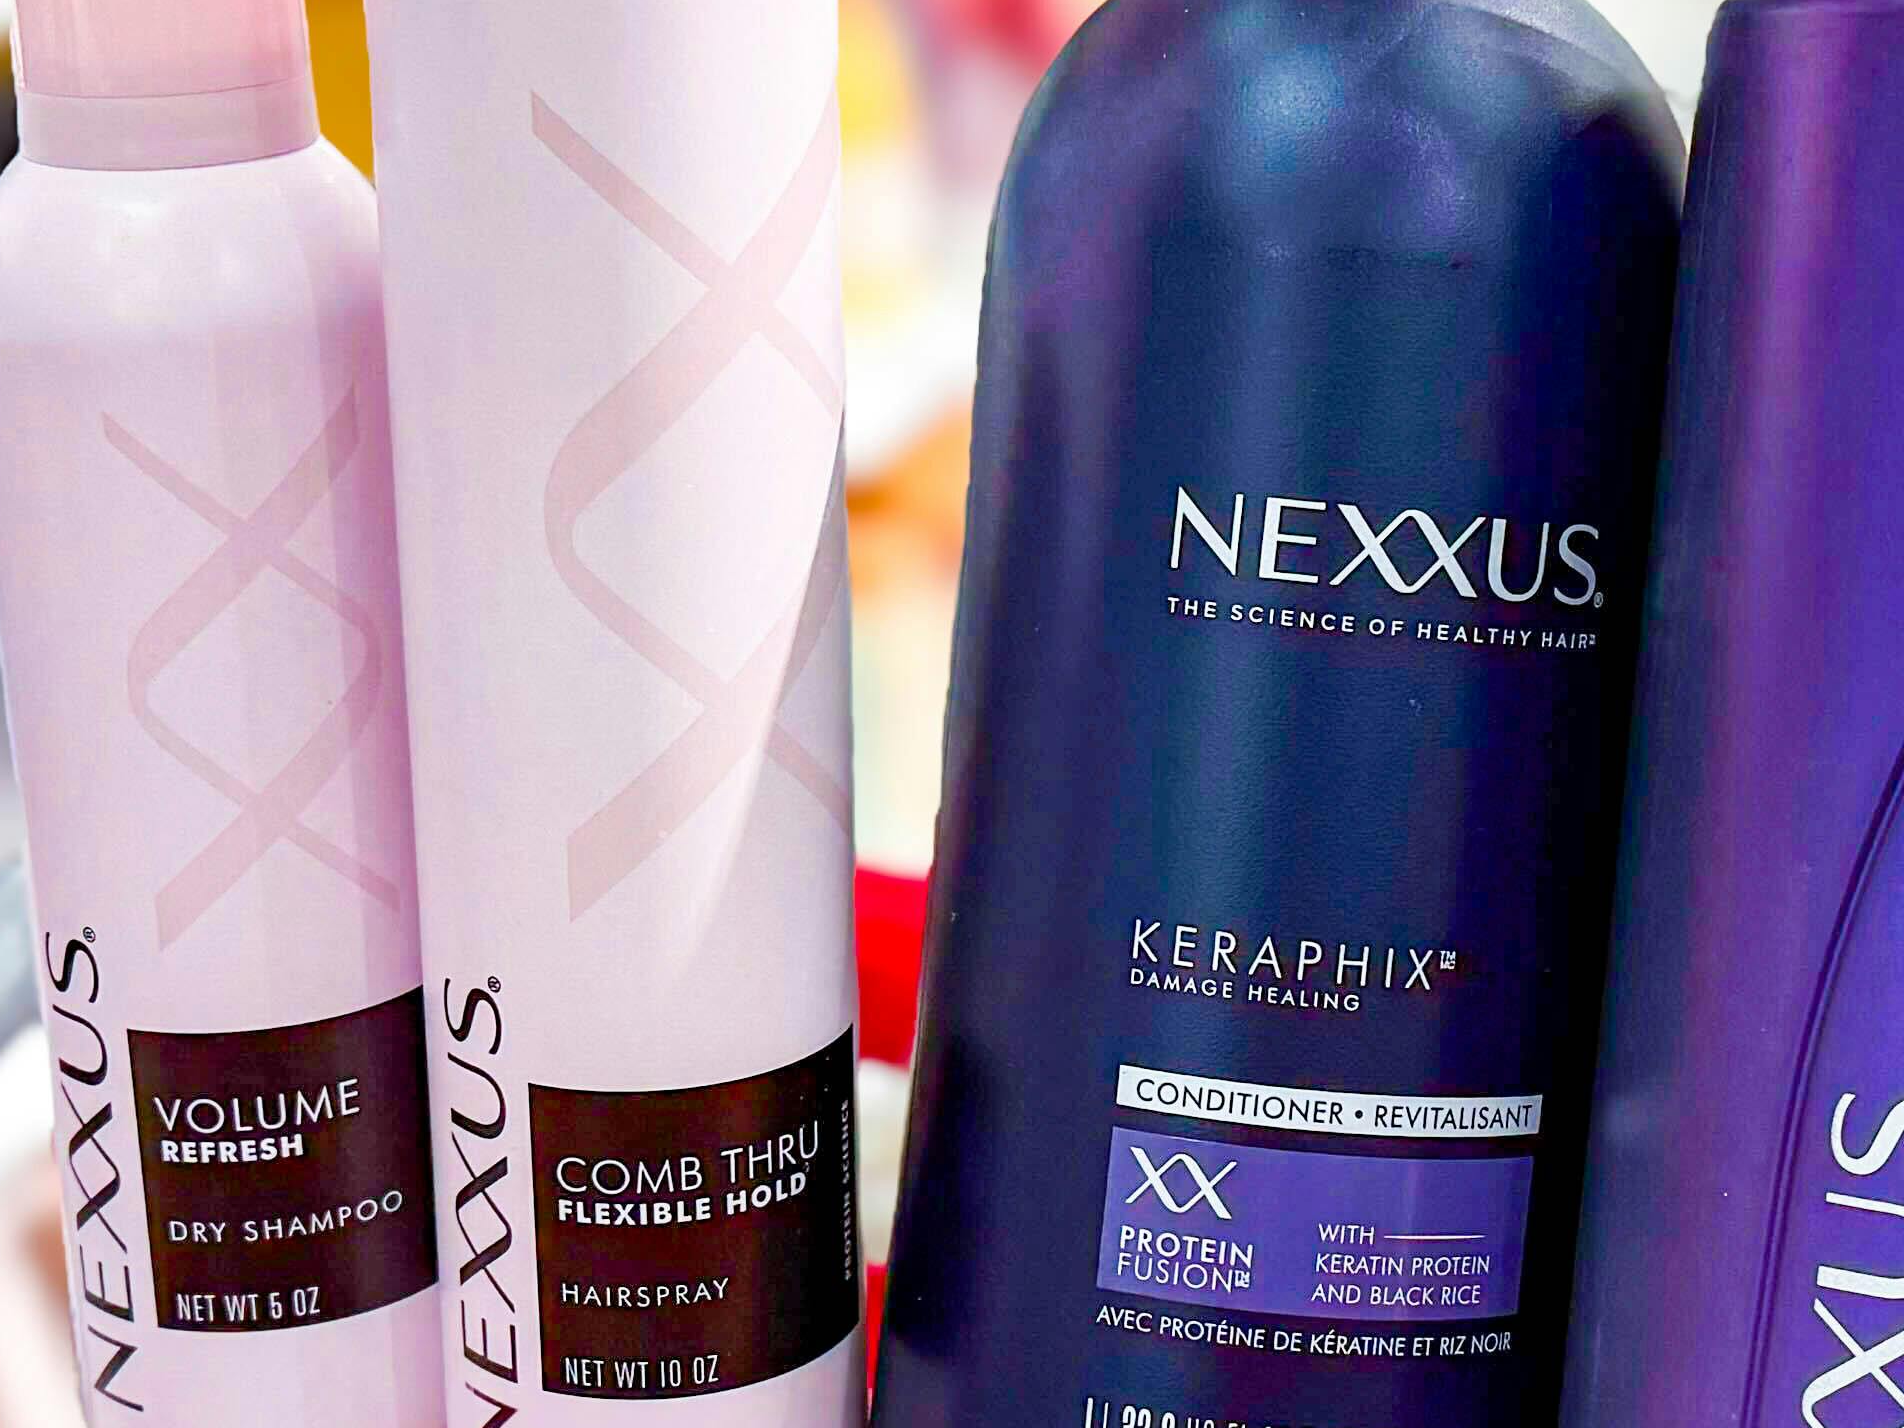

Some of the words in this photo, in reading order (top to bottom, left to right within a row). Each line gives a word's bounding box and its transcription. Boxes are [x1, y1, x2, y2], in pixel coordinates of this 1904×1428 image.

[1168, 597, 1217, 619] THE
[1231, 605, 1355, 633] SCIENCE
[1370, 619, 1404, 636] OF
[1417, 623, 1531, 648] HEALTHY
[1130, 968, 1233, 999] DAMAGE
[1248, 984, 1360, 1012] HEALING
[153, 1078, 360, 1134] VOLUME
[1135, 1078, 1344, 1125] CONDITIONER
[1374, 1104, 1534, 1131] REVITALISANT
[161, 1133, 304, 1163] REFRESH
[556, 1157, 703, 1195] COMB
[721, 1120, 819, 1183] THRU
[169, 1221, 226, 1243] DRY
[244, 1190, 403, 1241] SHAMPOO
[558, 1197, 711, 1225] FLEXIBLE
[726, 1172, 807, 1215] HOLD
[1119, 1225, 1254, 1269] PROTEIN
[1318, 1223, 1375, 1245] WITH
[1315, 1253, 1403, 1276] KERATIN
[1411, 1255, 1490, 1276] PROTEIN
[176, 1293, 216, 1322] NET
[225, 1294, 259, 1322] WT
[268, 1293, 283, 1319] 5
[292, 1286, 321, 1317] OZ
[561, 1277, 729, 1307] HAIRSPRAY
[1311, 1283, 1360, 1305] AND
[1369, 1285, 1433, 1306] BLACK
[1440, 1285, 1481, 1305] RICE
[1096, 1305, 1153, 1333] AVEC
[1159, 1316, 1265, 1349] PROTÉINE
[1273, 1331, 1302, 1352] DE
[1310, 1330, 1406, 1357] KÉRATINE
[1412, 1337, 1433, 1356] ET
[1439, 1332, 1465, 1356] RIZ
[1470, 1330, 1512, 1353] NOIR
[564, 1356, 605, 1388] NET
[614, 1360, 649, 1388] WT
[660, 1360, 682, 1387] 10
[693, 1354, 720, 1383] OZ
